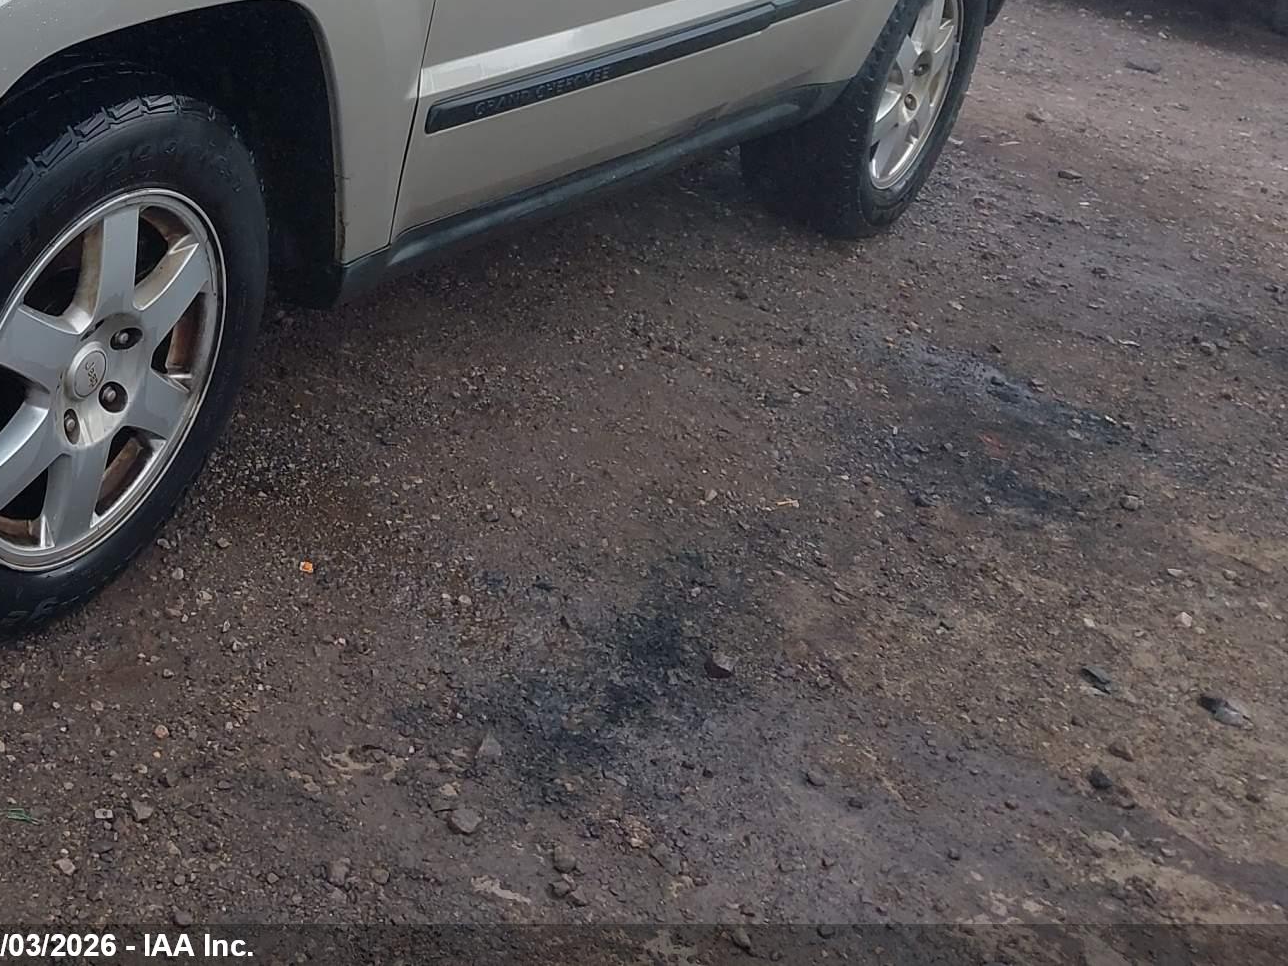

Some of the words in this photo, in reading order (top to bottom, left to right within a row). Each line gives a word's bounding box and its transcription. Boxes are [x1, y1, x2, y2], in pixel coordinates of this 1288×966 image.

[474, 90, 530, 115] GRAND
[535, 66, 611, 99] CHEROKEE
[84, 361, 99, 388] Jeep
